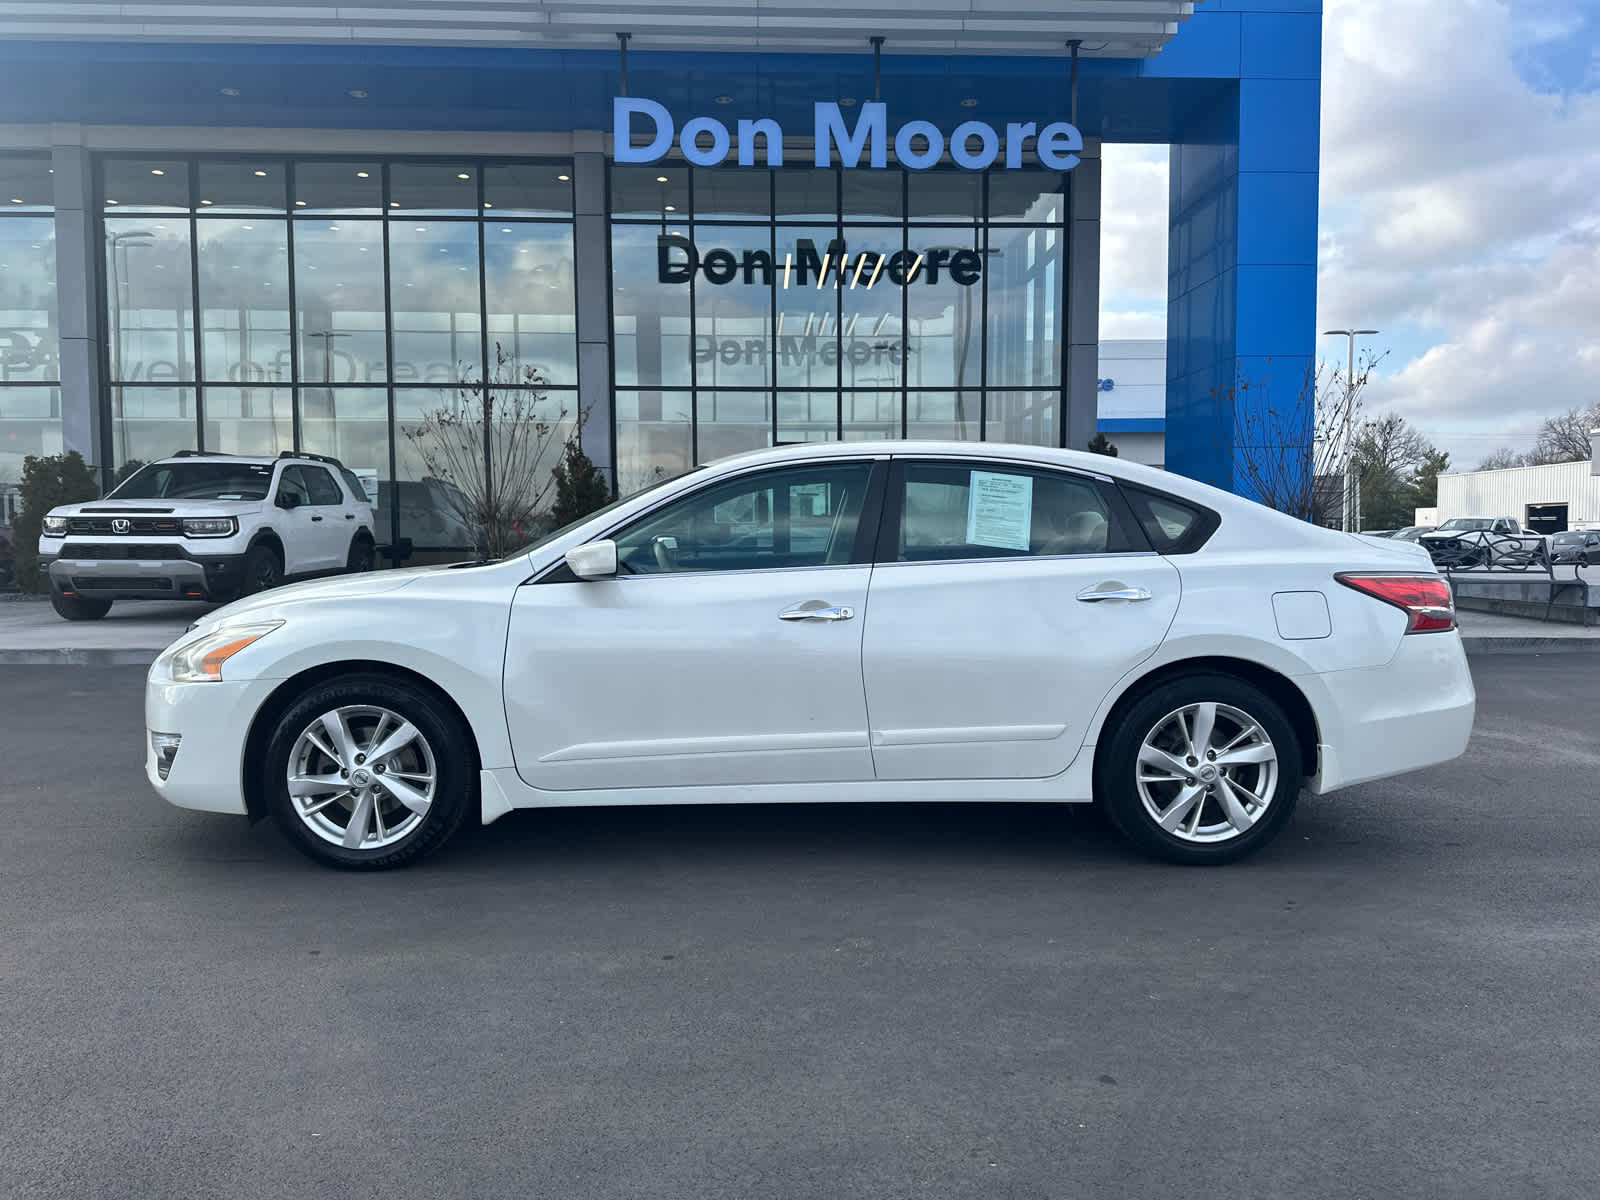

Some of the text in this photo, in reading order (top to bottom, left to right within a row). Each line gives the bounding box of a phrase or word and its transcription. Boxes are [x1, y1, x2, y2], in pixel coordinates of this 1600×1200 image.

[613, 97, 1084, 171] Don Moore
[657, 234, 982, 287] Don Moore
